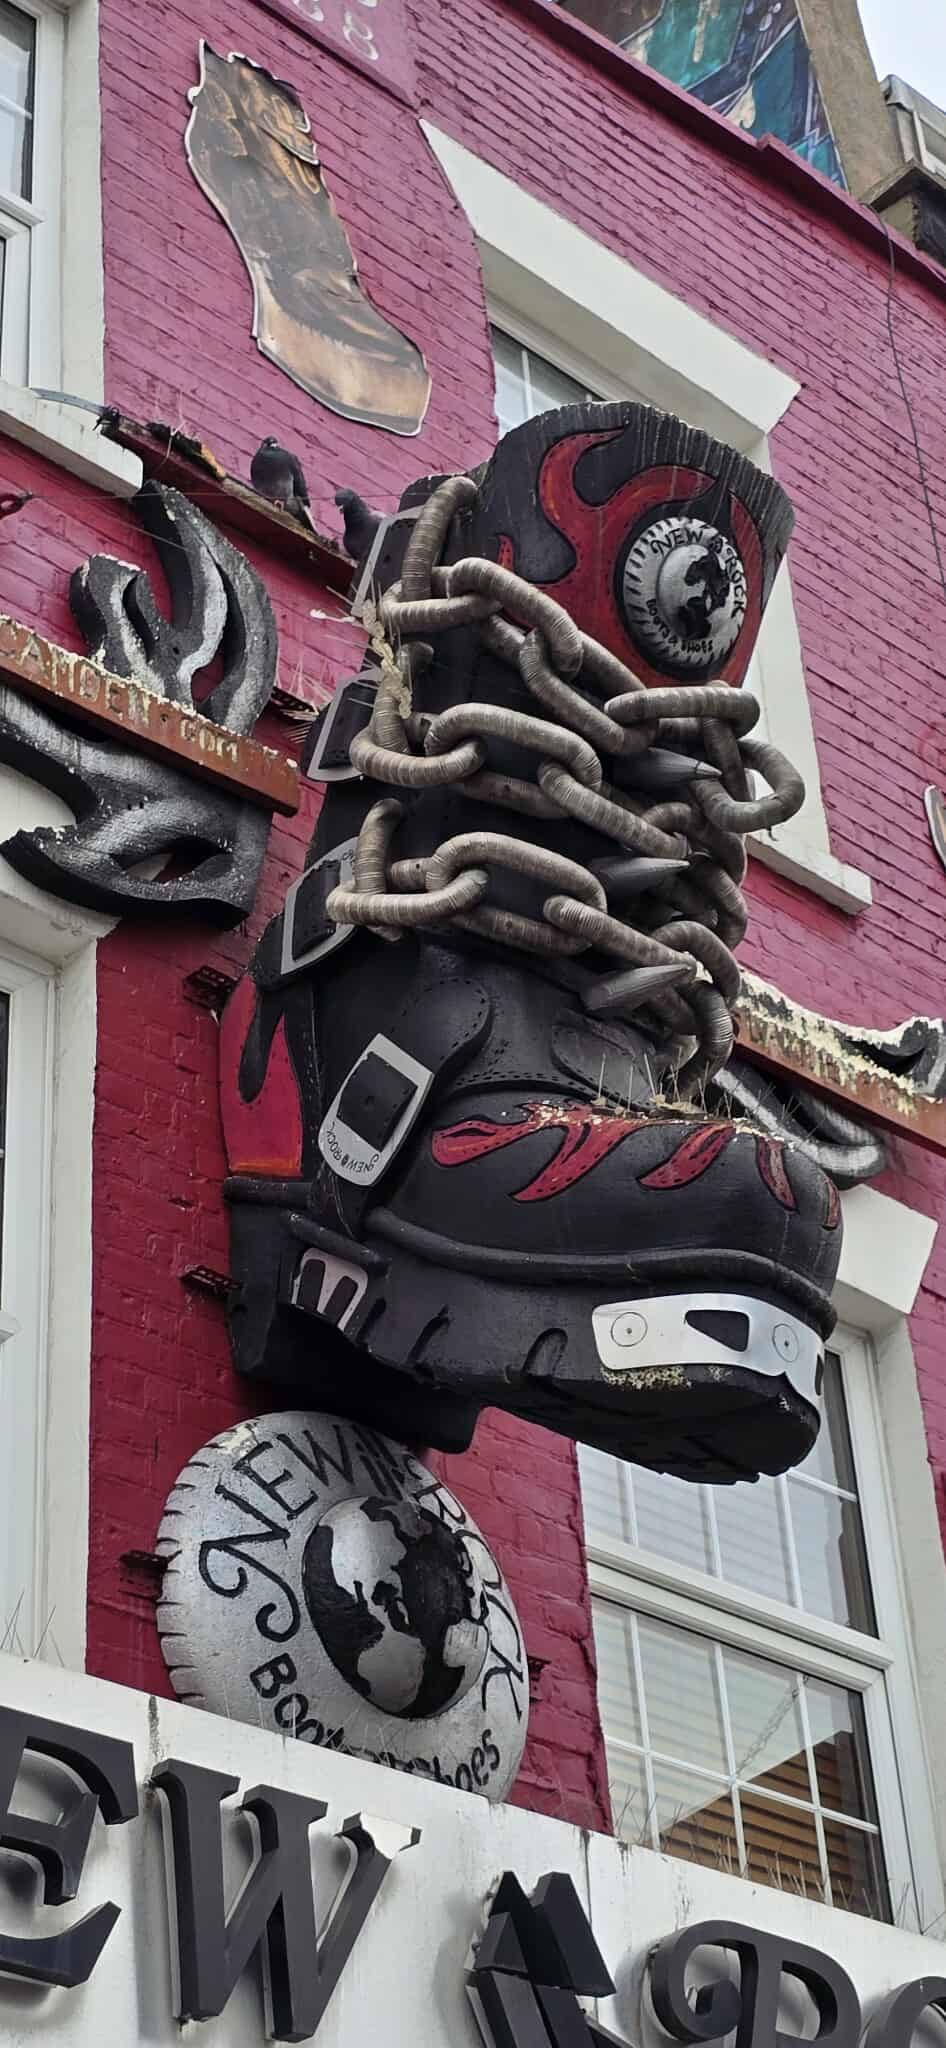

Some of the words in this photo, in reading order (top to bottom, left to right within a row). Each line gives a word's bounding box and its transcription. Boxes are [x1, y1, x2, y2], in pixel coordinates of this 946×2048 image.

[651, 528, 703, 556] NEW
[725, 547, 746, 618] ROCK
[326, 1120, 343, 1161] ROCK
[346, 1153, 380, 1174] NEW
[198, 1423, 354, 1643] NEW
